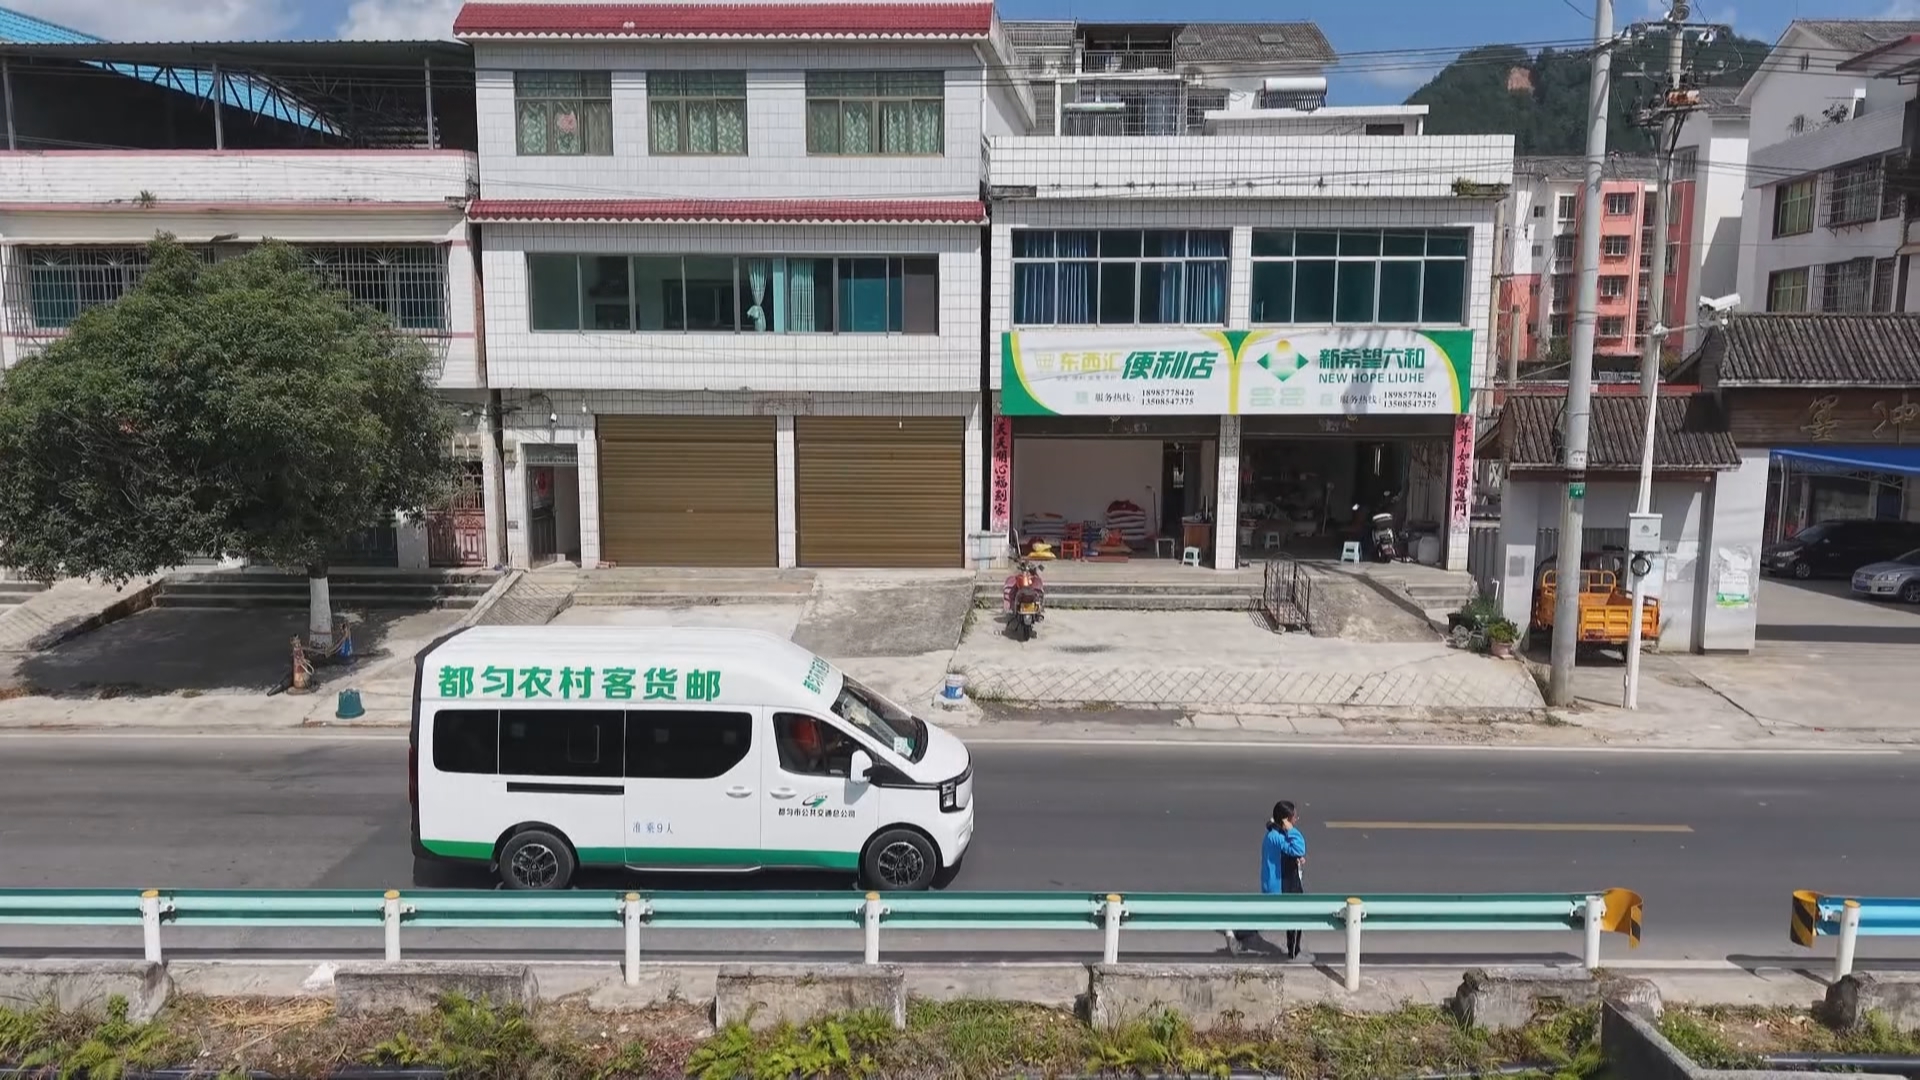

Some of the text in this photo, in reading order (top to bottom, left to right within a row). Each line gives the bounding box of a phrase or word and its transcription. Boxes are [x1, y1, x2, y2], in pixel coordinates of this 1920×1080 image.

[1319, 348, 1425, 369] 新希望六和
[1059, 351, 1218, 380] 东西汇 便利店
[1319, 373, 1425, 384] NEW HOPE LIUHE
[1141, 388, 1194, 397] 18985778426
[1384, 391, 1437, 399] 18985778426
[1141, 397, 1194, 406] 13508547375
[1384, 400, 1437, 408] 13508547375
[438, 665, 721, 702] 都匀农村客货邮
[778, 807, 856, 818] 都匀市公共交通总公司
